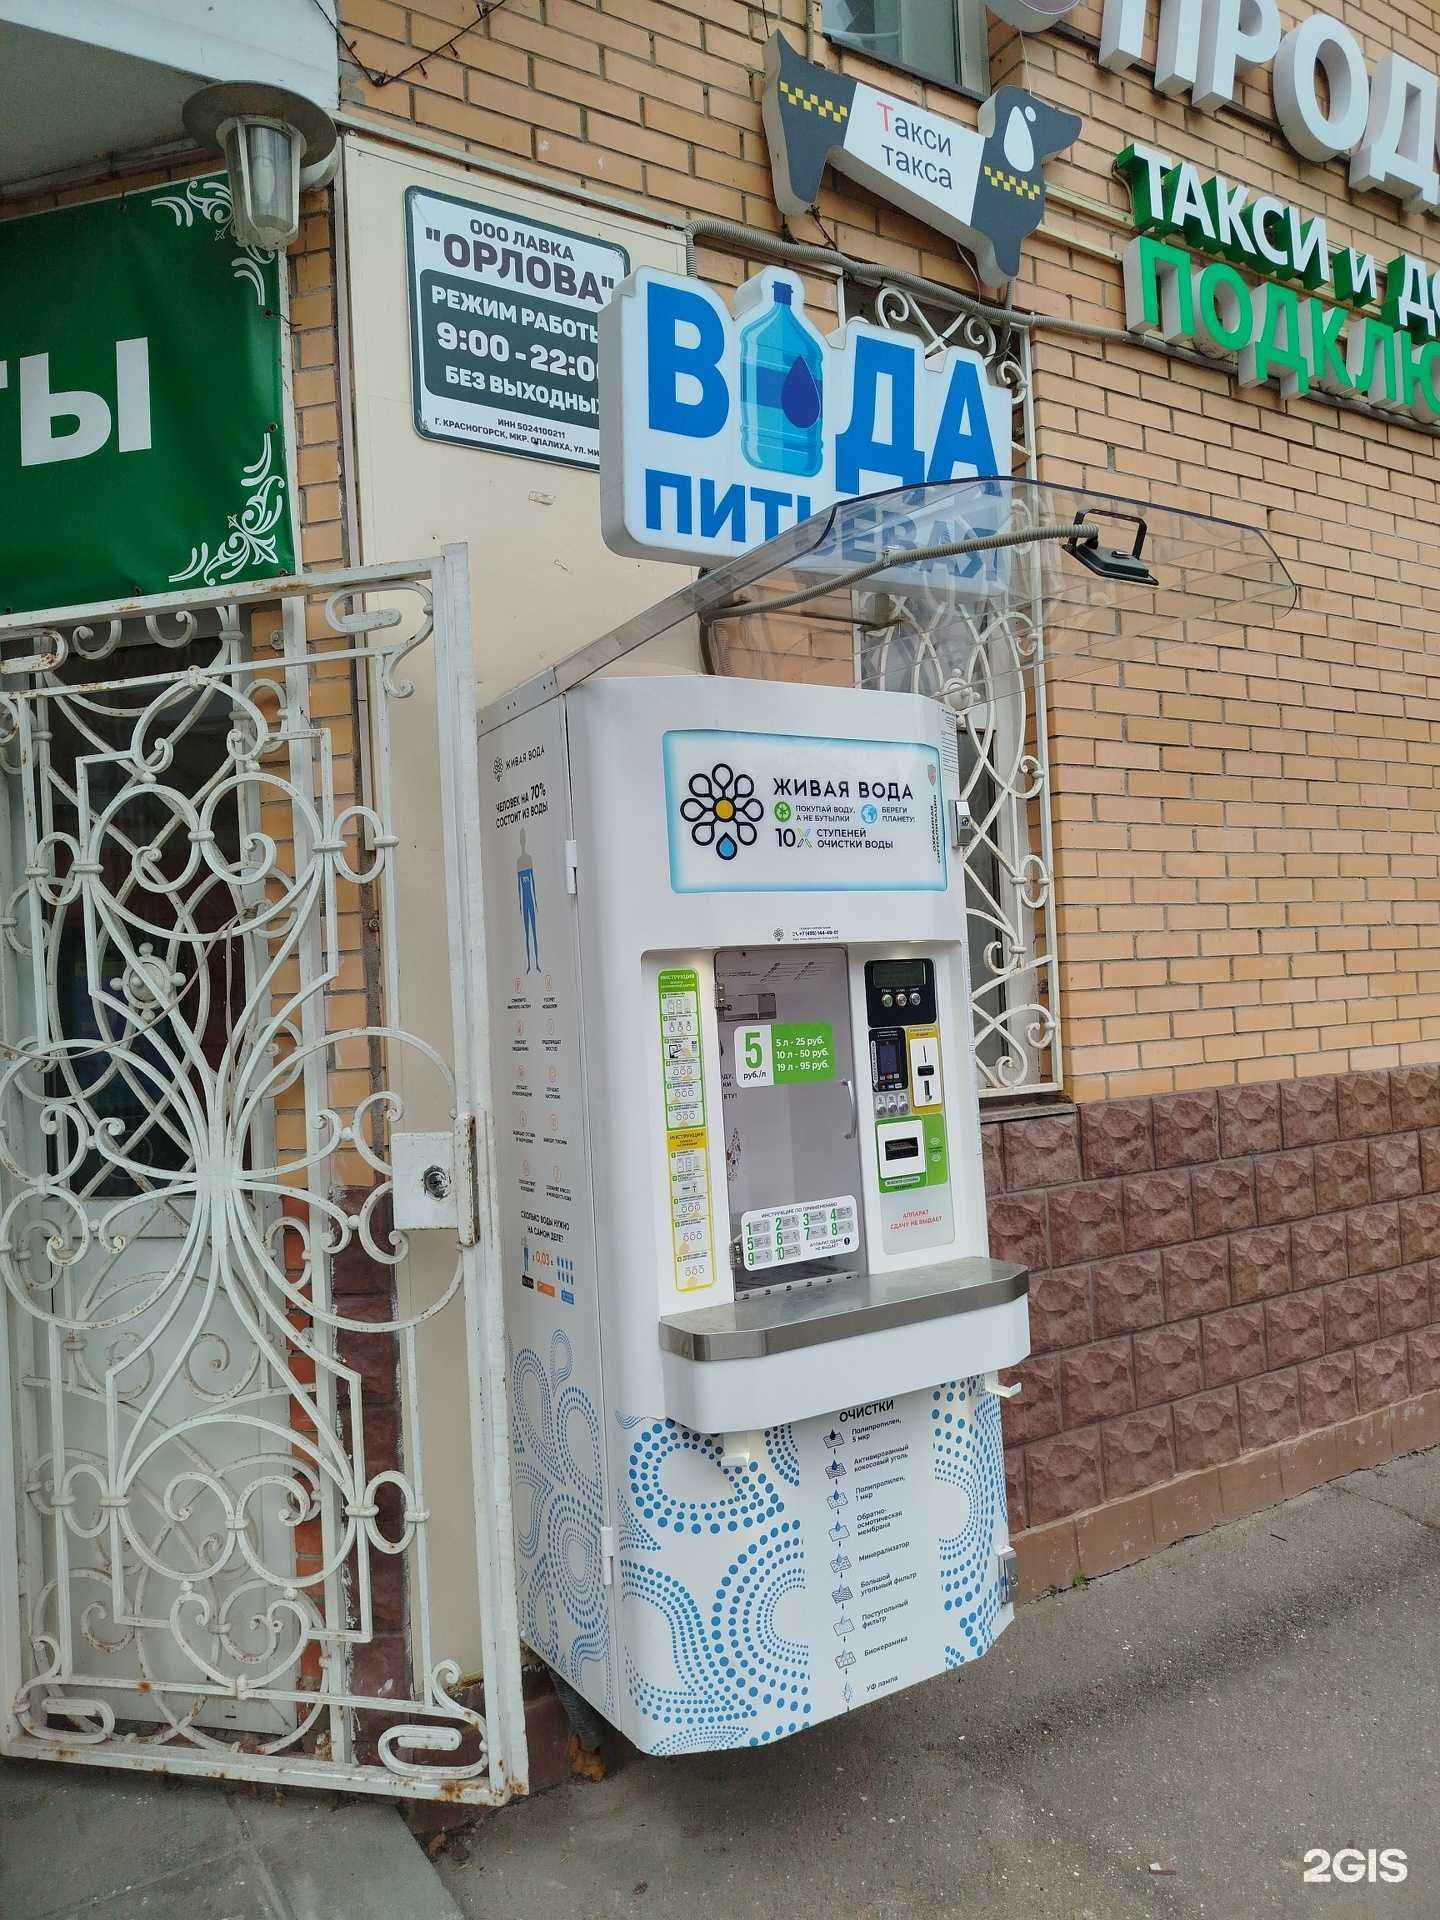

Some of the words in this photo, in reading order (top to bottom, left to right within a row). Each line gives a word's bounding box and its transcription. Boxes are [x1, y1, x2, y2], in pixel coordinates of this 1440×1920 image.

[876, 102, 952, 157] Такси
[882, 145, 952, 190] такса
[470, 219, 509, 244] ООО
[513, 231, 574, 261] ЛАВКА
[1131, 143, 1331, 285] ТАКСИ
[1398, 254, 1440, 338] Д
[425, 227, 615, 304] "ОРЛОВА"
[431, 285, 516, 324] РЕЖИМ
[1134, 236, 1440, 415] ПОДКЛЮ
[436, 322, 509, 362] 9:00
[529, 344, 599, 382] 22:0
[445, 365, 485, 390] БЕЗ
[490, 376, 599, 414] ВЫХОДНЫ
[0, 337, 152, 467] Ы
[443, 419, 508, 439] КРАСНОГОРСК,
[509, 432, 529, 443] МКР.
[573, 445, 586, 455] УЛ.
[497, 418, 516, 429] ИНН
[517, 422, 566, 439] 5024100211
[505, 753, 527, 771] ЖИВАЯ
[528, 745, 545, 760] ВОДА
[495, 796, 520, 812] ЧЕЛОВЕК
[531, 782, 546, 800] 70%
[773, 777, 850, 798] ЖИВАЯ
[858, 782, 914, 801] ВОДА
[495, 810, 521, 828] СОСТОИТ
[795, 804, 832, 813] ПОКУПАЙ
[881, 806, 908, 814] БЕРЕГИ
[816, 827, 867, 838] СТУПЕНЕЙ
[817, 839, 863, 849] ОЧИСТКИ
[865, 840, 894, 849] ВОДЫ
[745, 1032, 763, 1069] 5
[776, 1039, 781, 1047] 5
[795, 1037, 806, 1046] 25
[807, 1036, 825, 1048] руб.
[777, 1051, 785, 1059] 10
[800, 1049, 810, 1058] 50
[812, 1048, 830, 1059] руб.
[743, 1070, 767, 1081] руб./л
[777, 1063, 785, 1072] 19
[799, 1061, 811, 1070] 95
[812, 1060, 830, 1071] руб.
[745, 1222, 752, 1236] 1
[775, 1217, 782, 1231] 2
[803, 1213, 810, 1226] 3
[830, 1208, 837, 1221] 4
[903, 1209, 929, 1218] АППАРАТ
[747, 1237, 754, 1251] 5
[776, 1232, 783, 1246] 6
[803, 1227, 810, 1240] 7
[832, 1223, 838, 1236] 8
[748, 1253, 755, 1266] 9
[775, 1247, 785, 1261] 10
[839, 1400, 894, 1423] ОЧИСТКИ
[851, 1418, 902, 1435] Полипропилен,
[857, 1433, 871, 1443] мкр
[854, 1444, 909, 1464] Активированный
[854, 1458, 890, 1472] кокосовый
[890, 1453, 908, 1468] уголь
[855, 1475, 906, 1494] Полипропилен,
[860, 1492, 873, 1501] мкр
[856, 1508, 887, 1521] Обратно-
[857, 1511, 903, 1529] осмотическая
[857, 1522, 891, 1536] мембрана
[858, 1541, 910, 1561] Минерализатор
[860, 1573, 890, 1588] Большой
[860, 1580, 892, 1597] угольный
[893, 1572, 917, 1587] фильтр
[861, 1600, 909, 1621] Постугольный
[862, 1616, 887, 1630] фильтр
[864, 1635, 908, 1656] Биокерамика
[878, 1675, 898, 1688] лампа
